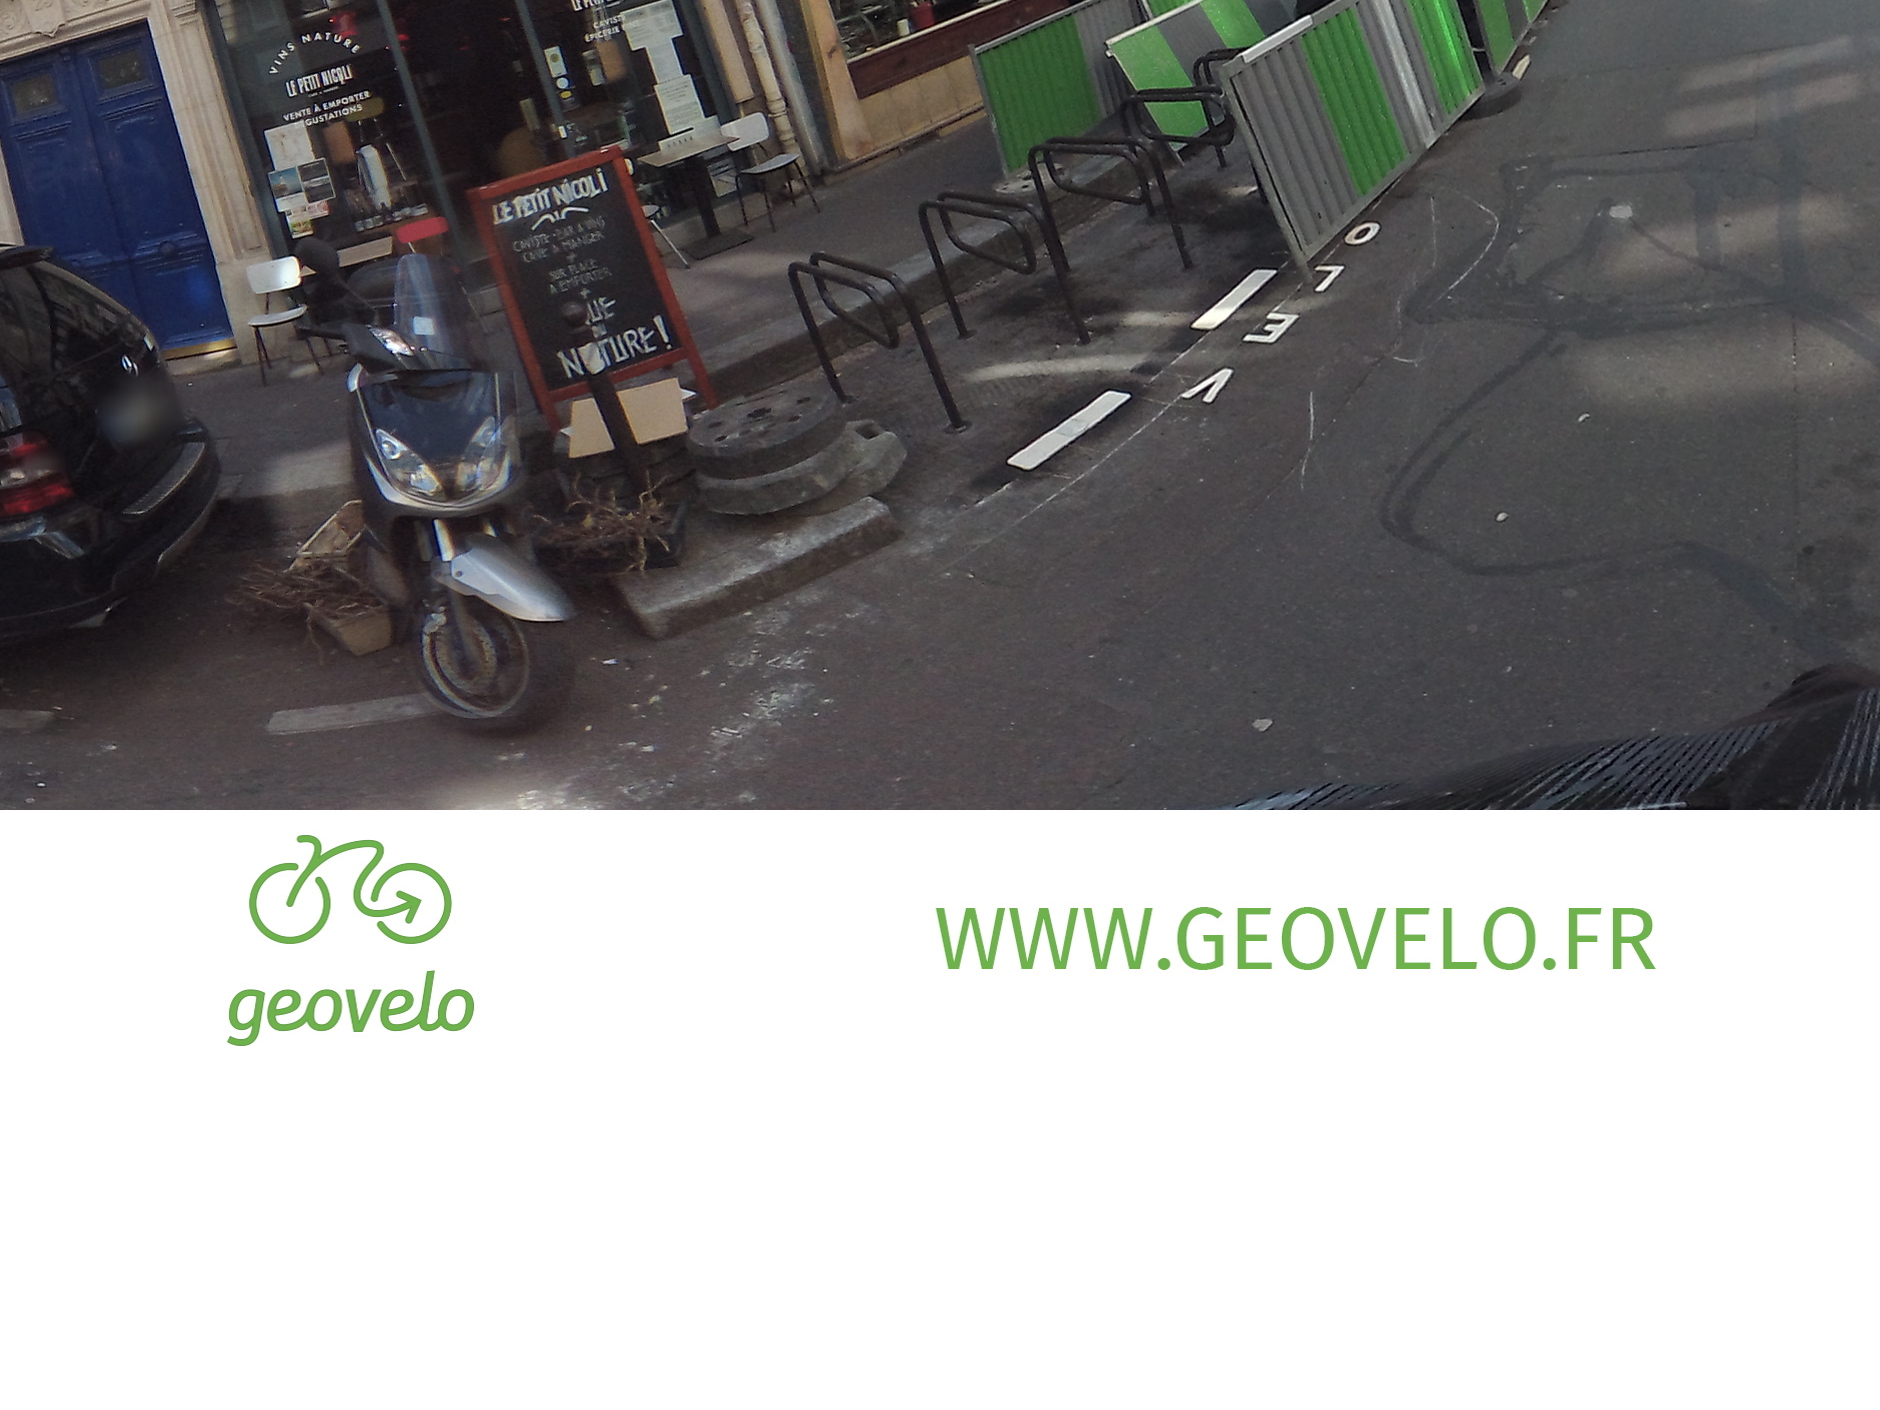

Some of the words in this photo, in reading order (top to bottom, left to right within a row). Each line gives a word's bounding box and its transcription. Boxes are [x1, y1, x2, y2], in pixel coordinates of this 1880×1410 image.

[268, 41, 296, 76] VINS
[300, 31, 362, 55] NATURE
[285, 79, 298, 98] LE
[296, 73, 321, 95] PETIT
[320, 65, 354, 87] NICOLI
[282, 107, 312, 122] VENTE
[322, 89, 372, 111] EMPORTER
[492, 200, 515, 226] LE
[583, 295, 617, 325] UE
